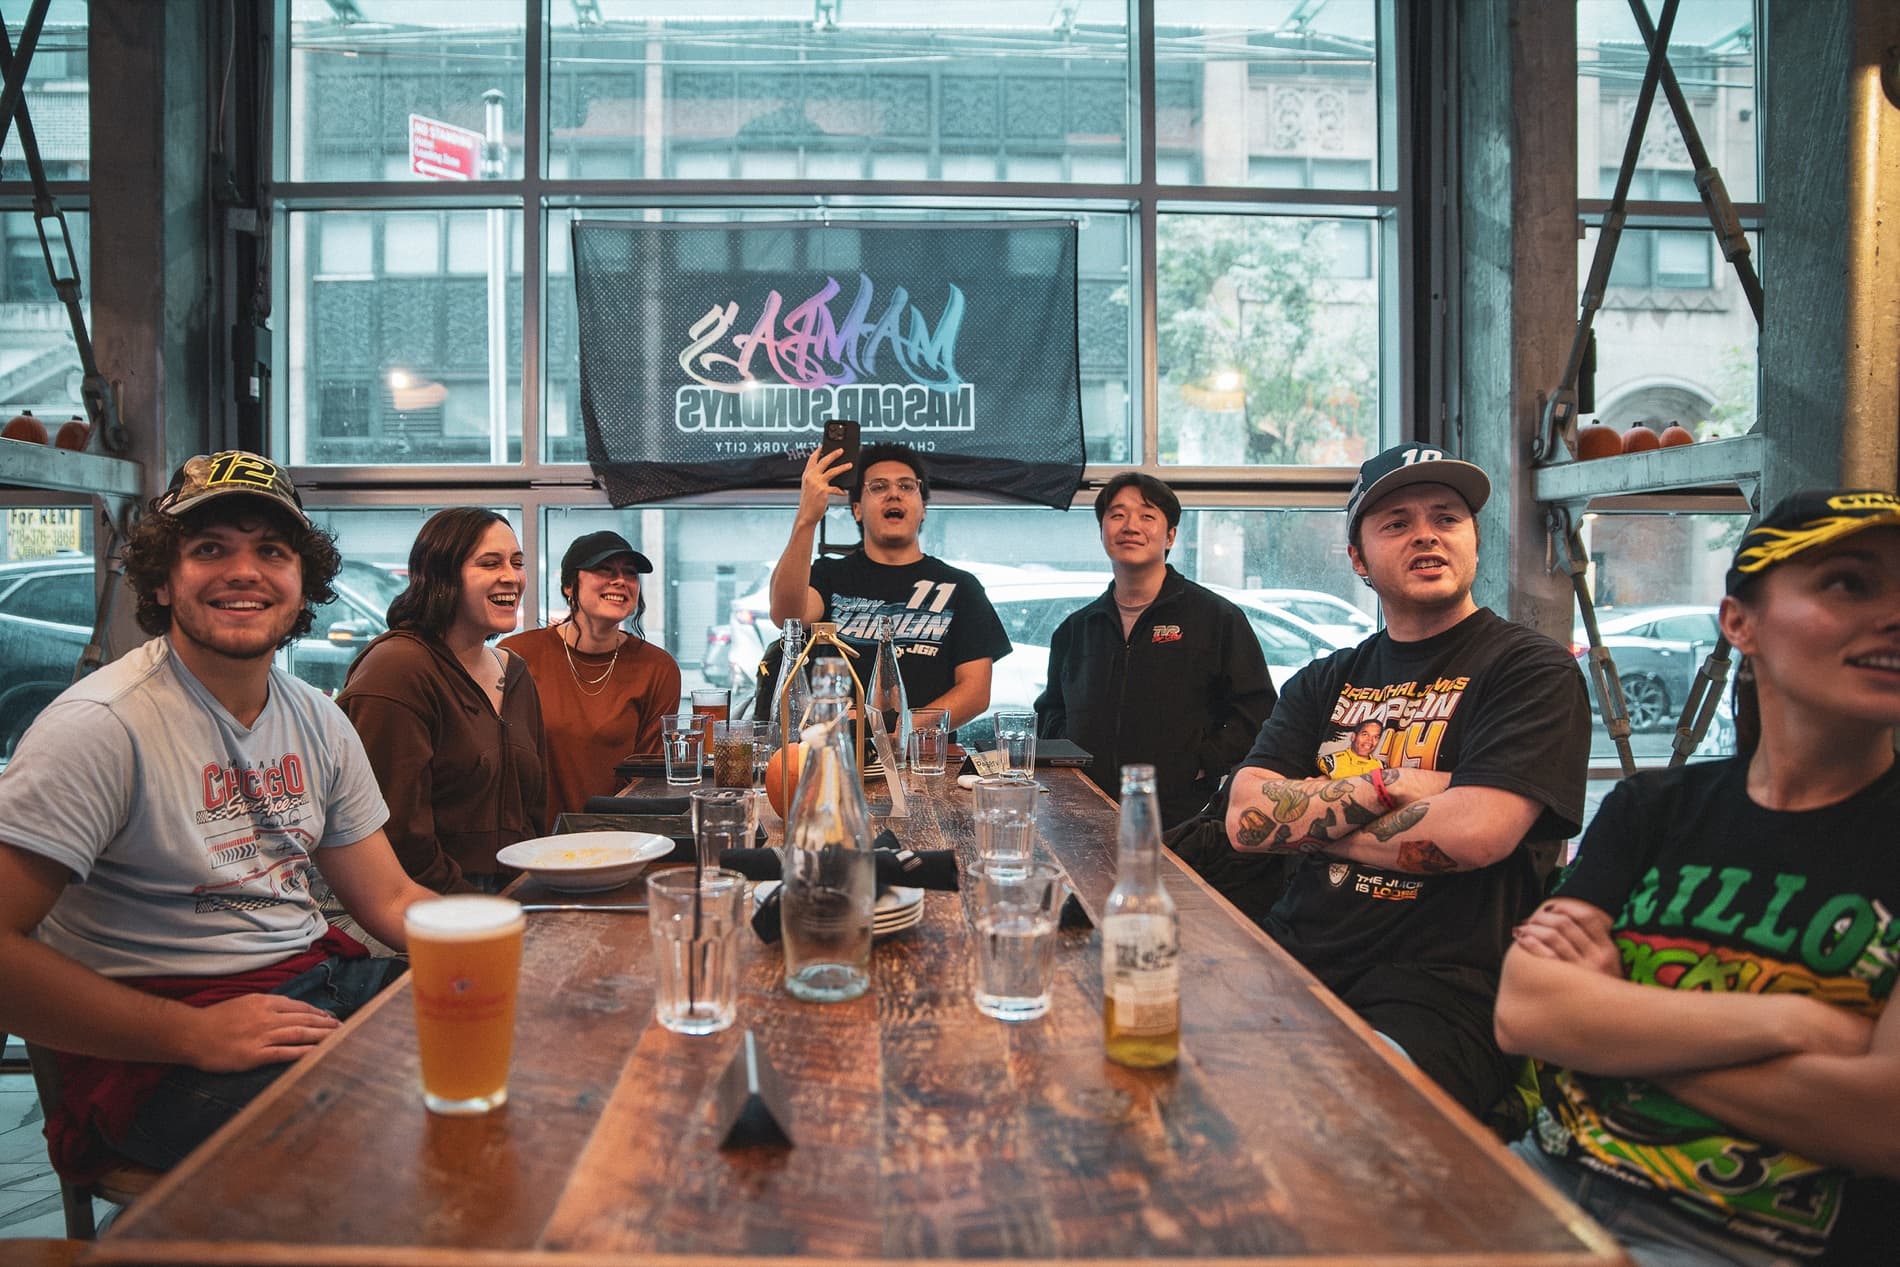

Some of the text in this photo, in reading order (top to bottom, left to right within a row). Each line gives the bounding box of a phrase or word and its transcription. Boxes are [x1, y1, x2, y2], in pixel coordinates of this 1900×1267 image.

[206, 453, 278, 489] 12
[906, 579, 957, 613] 11
[907, 643, 939, 657] JGR
[1356, 873, 1384, 886] THE
[1355, 883, 1370, 893] IS
